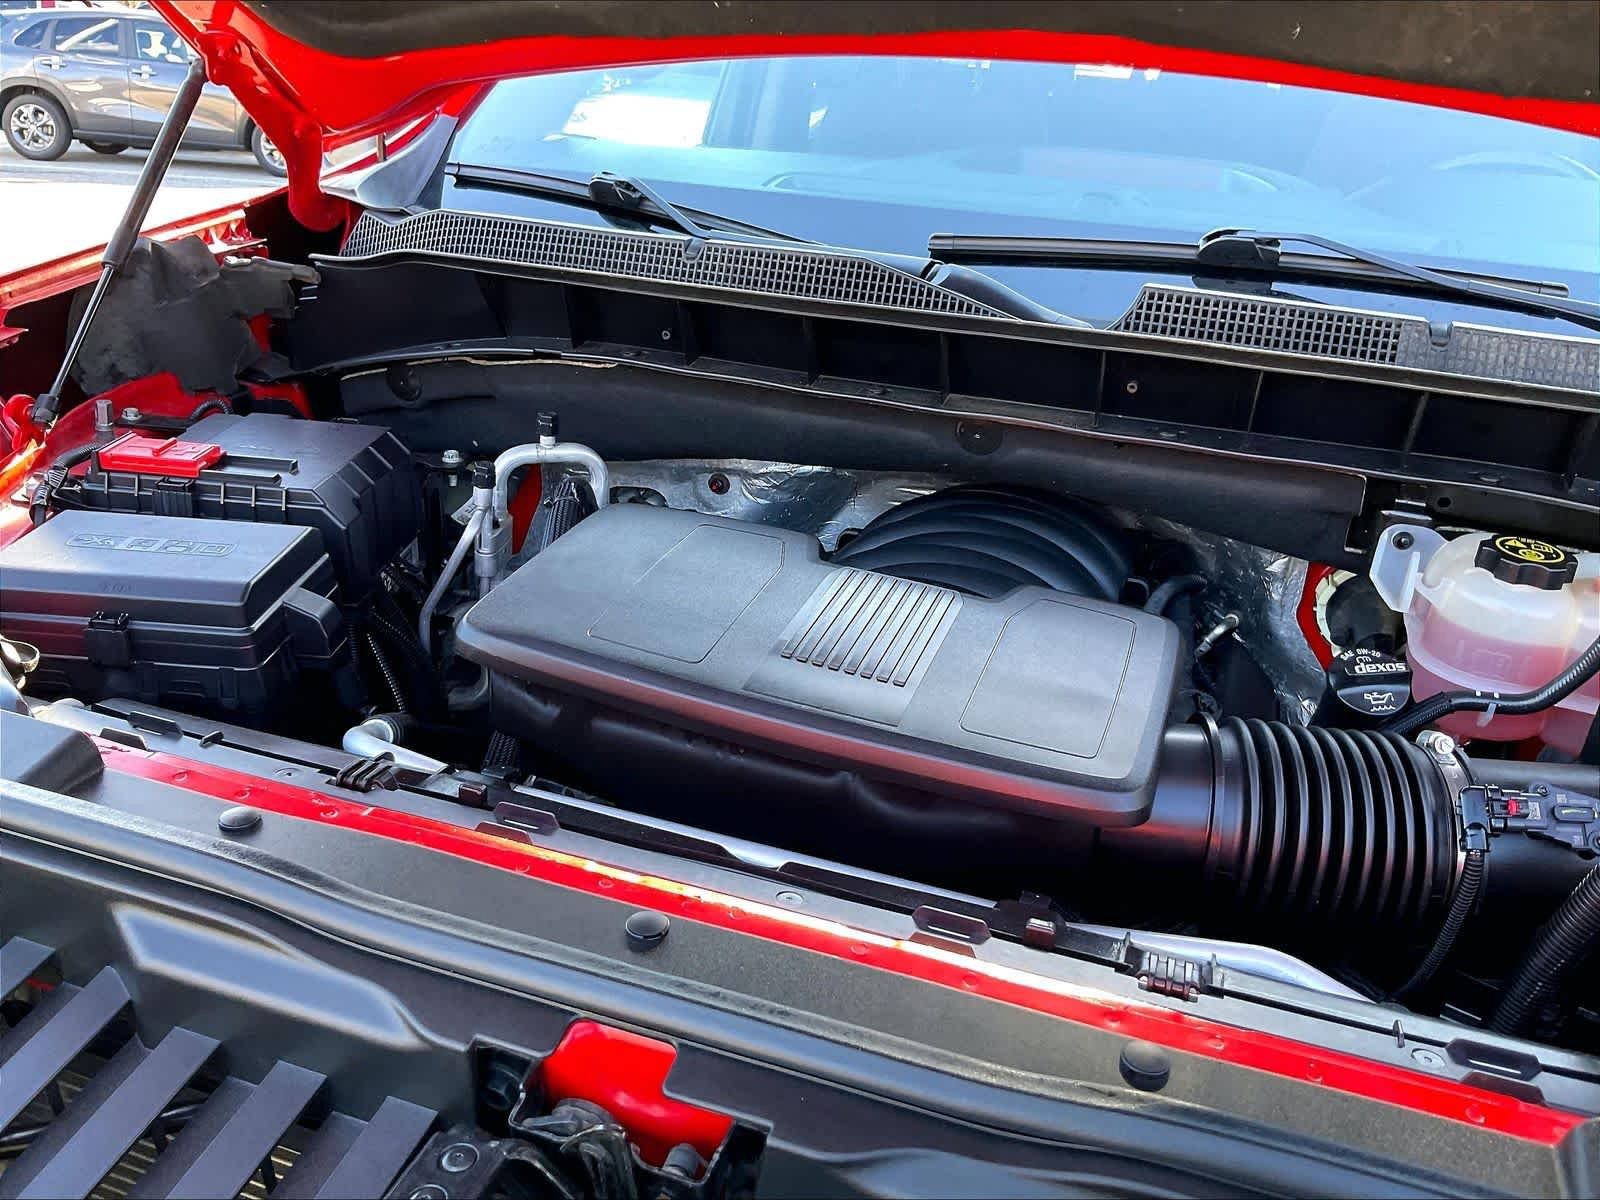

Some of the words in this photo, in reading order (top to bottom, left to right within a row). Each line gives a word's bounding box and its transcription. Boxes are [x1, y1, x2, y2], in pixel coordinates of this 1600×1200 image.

[1340, 650, 1355, 661] SAE
[1356, 648, 1381, 658] 0W-20
[1354, 662, 1406, 674] dexos
